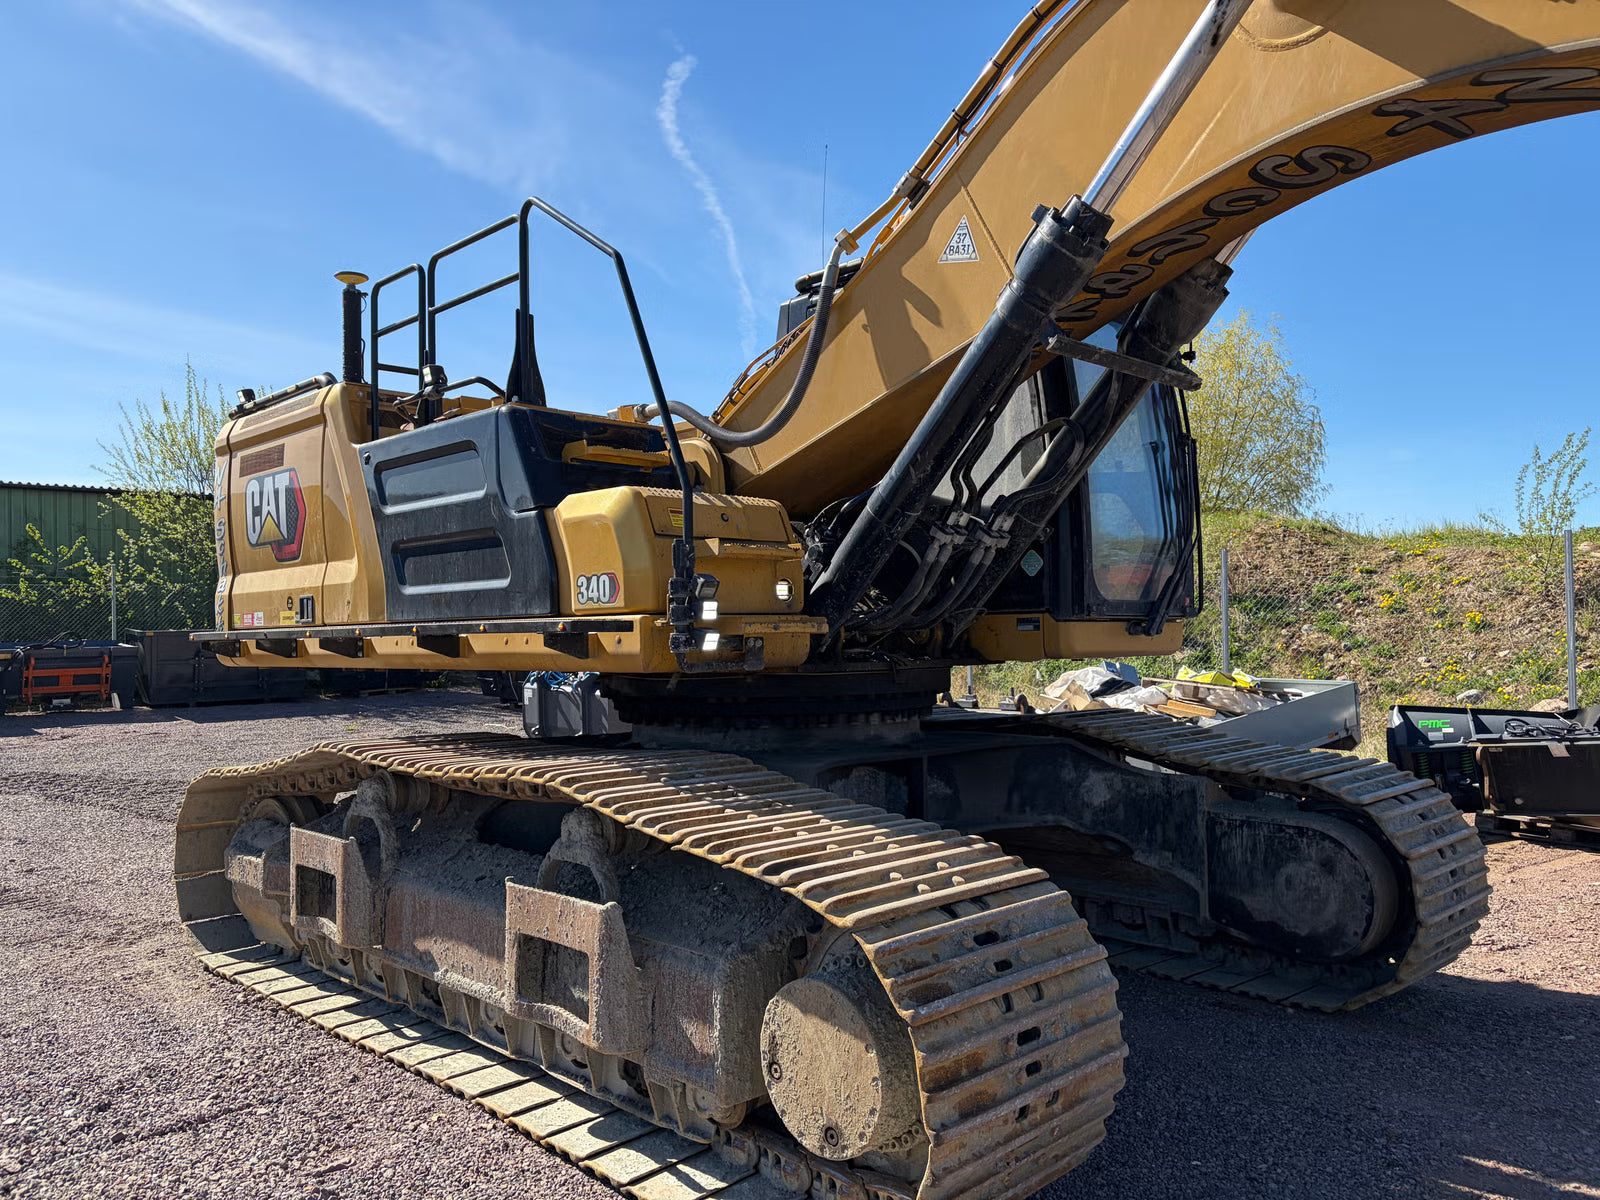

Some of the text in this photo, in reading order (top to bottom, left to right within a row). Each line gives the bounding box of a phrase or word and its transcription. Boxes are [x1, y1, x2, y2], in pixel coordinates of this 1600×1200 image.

[955, 233, 967, 244] 37
[246, 472, 290, 545] CAT
[577, 574, 610, 604] 340
[1418, 720, 1450, 728] PMC
